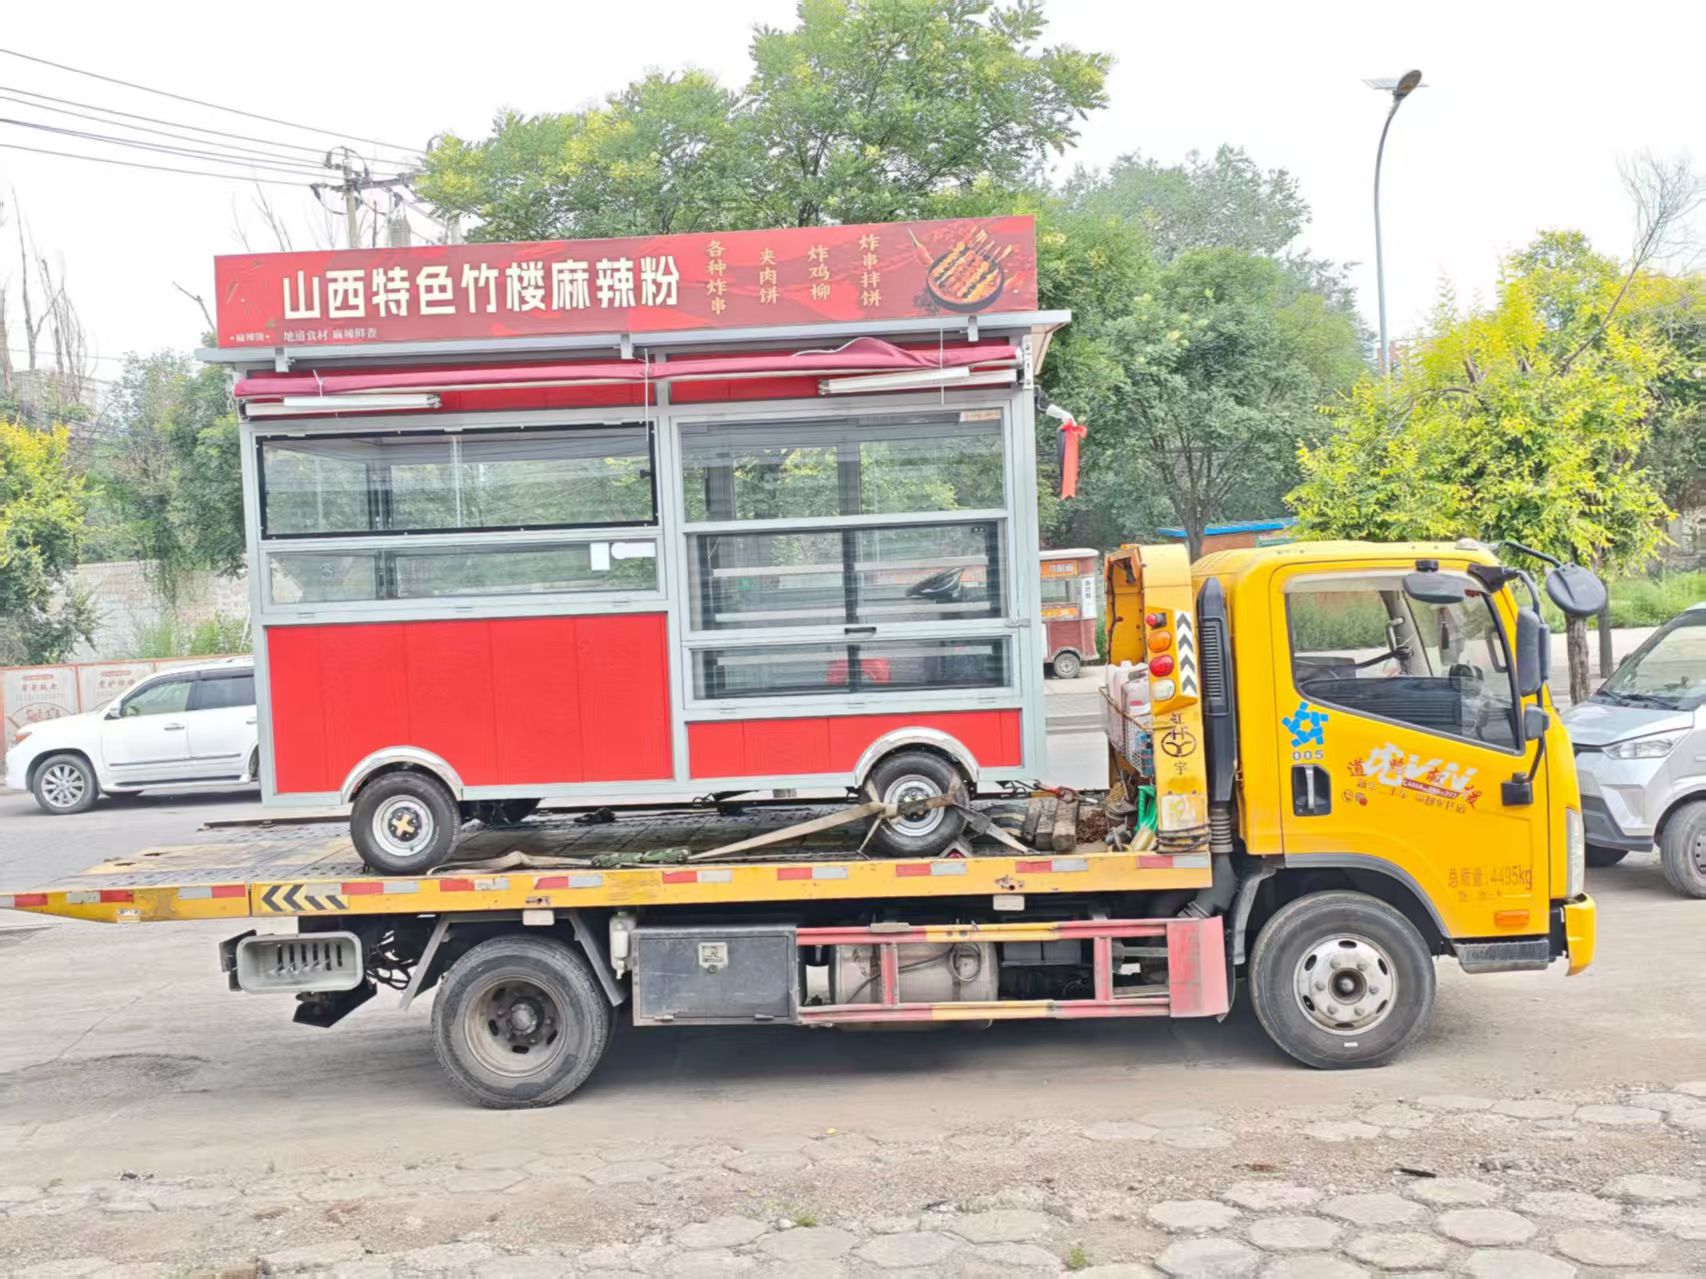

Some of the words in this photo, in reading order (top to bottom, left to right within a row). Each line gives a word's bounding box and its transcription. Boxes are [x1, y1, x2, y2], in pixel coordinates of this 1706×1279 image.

[282, 255, 680, 320] 山西特色竹楼麻辣粉
[706, 240, 726, 316] 各种炸串
[759, 248, 779, 304] 夹肉饼
[808, 245, 831, 301] 炸鸡柳
[859, 234, 882, 307] 炸串拌饼
